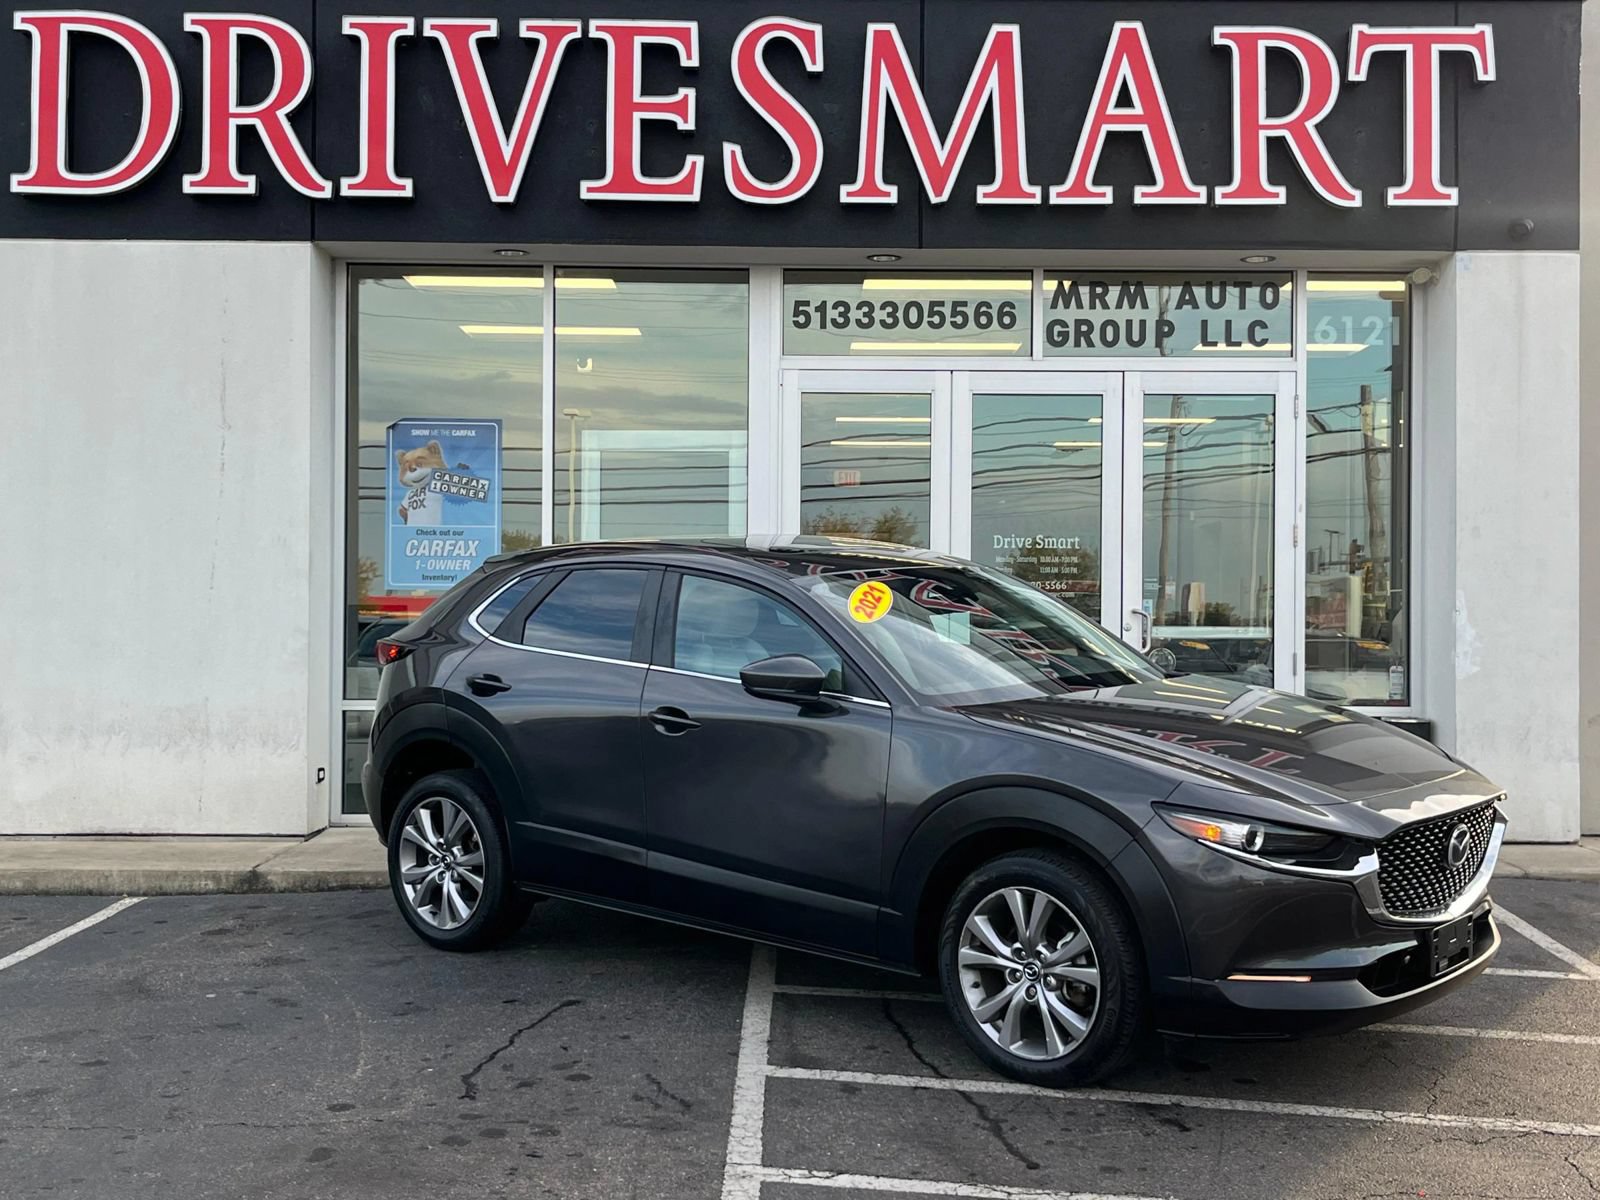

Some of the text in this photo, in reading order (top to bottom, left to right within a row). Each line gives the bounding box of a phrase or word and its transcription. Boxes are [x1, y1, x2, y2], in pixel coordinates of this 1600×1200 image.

[9, 10, 1496, 208] DRIVESMART
[1049, 281, 1280, 310] MRM AUTO
[792, 300, 1017, 330] 5133305566
[1046, 318, 1270, 348] GROUP LLC
[1314, 315, 1400, 346] 6121
[451, 429, 476, 437] CARFAX
[434, 471, 489, 490] CARFAX
[408, 486, 427, 500] CAR
[407, 497, 427, 511] FOX
[416, 528, 437, 536] Check
[406, 539, 479, 557] CARFAX
[993, 534, 1081, 549] Drive Smart
[415, 560, 471, 571] 1-OWNER
[422, 574, 457, 582] Inventory!
[854, 584, 886, 620] 2021
